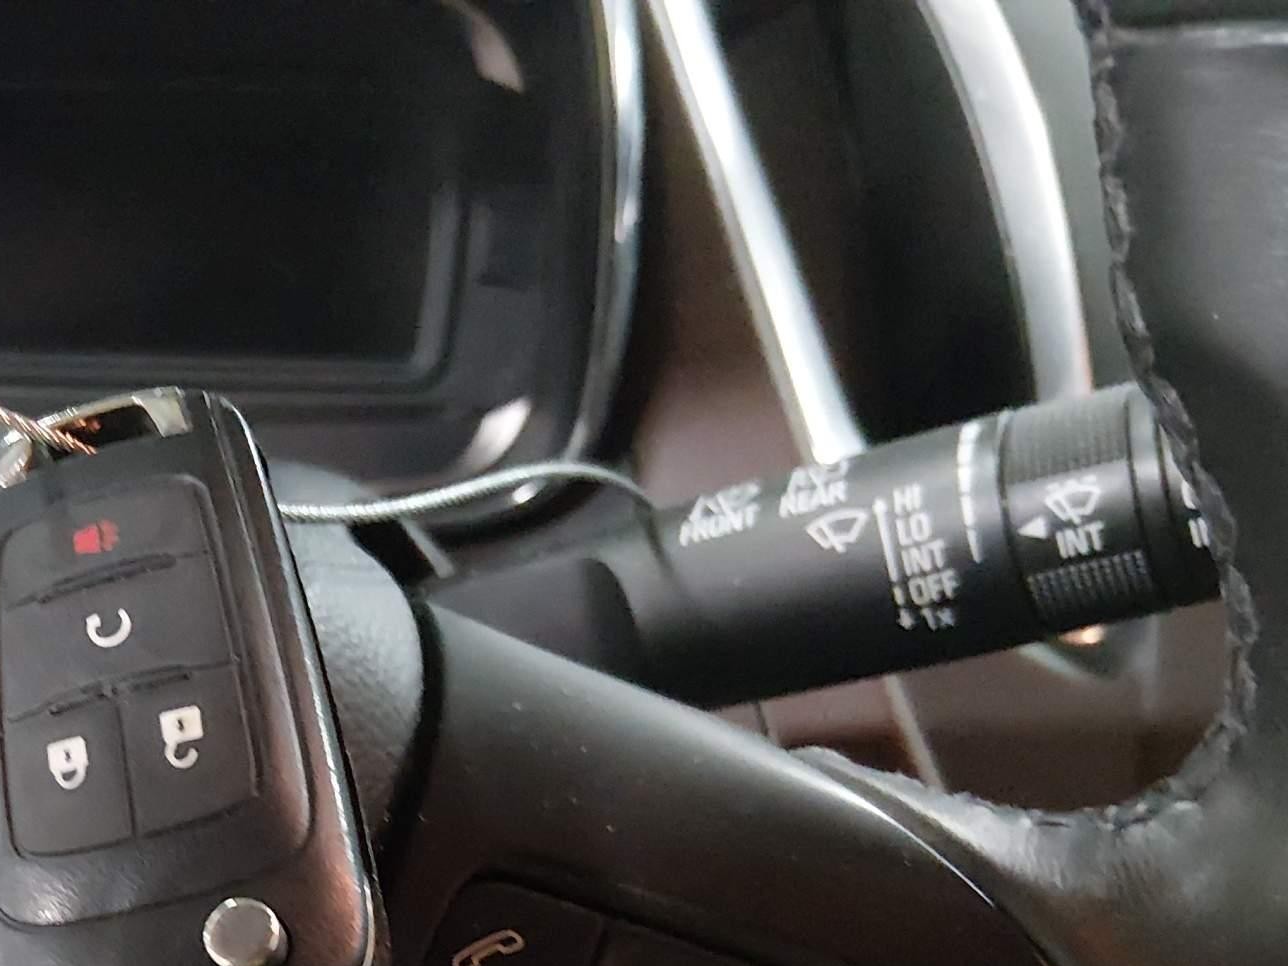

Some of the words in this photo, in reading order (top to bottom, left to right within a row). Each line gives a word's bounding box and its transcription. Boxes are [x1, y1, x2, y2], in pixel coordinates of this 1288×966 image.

[895, 512, 932, 546] LO
[1055, 520, 1104, 559] INT
[900, 538, 947, 576] INT
[907, 567, 960, 606] OFF
